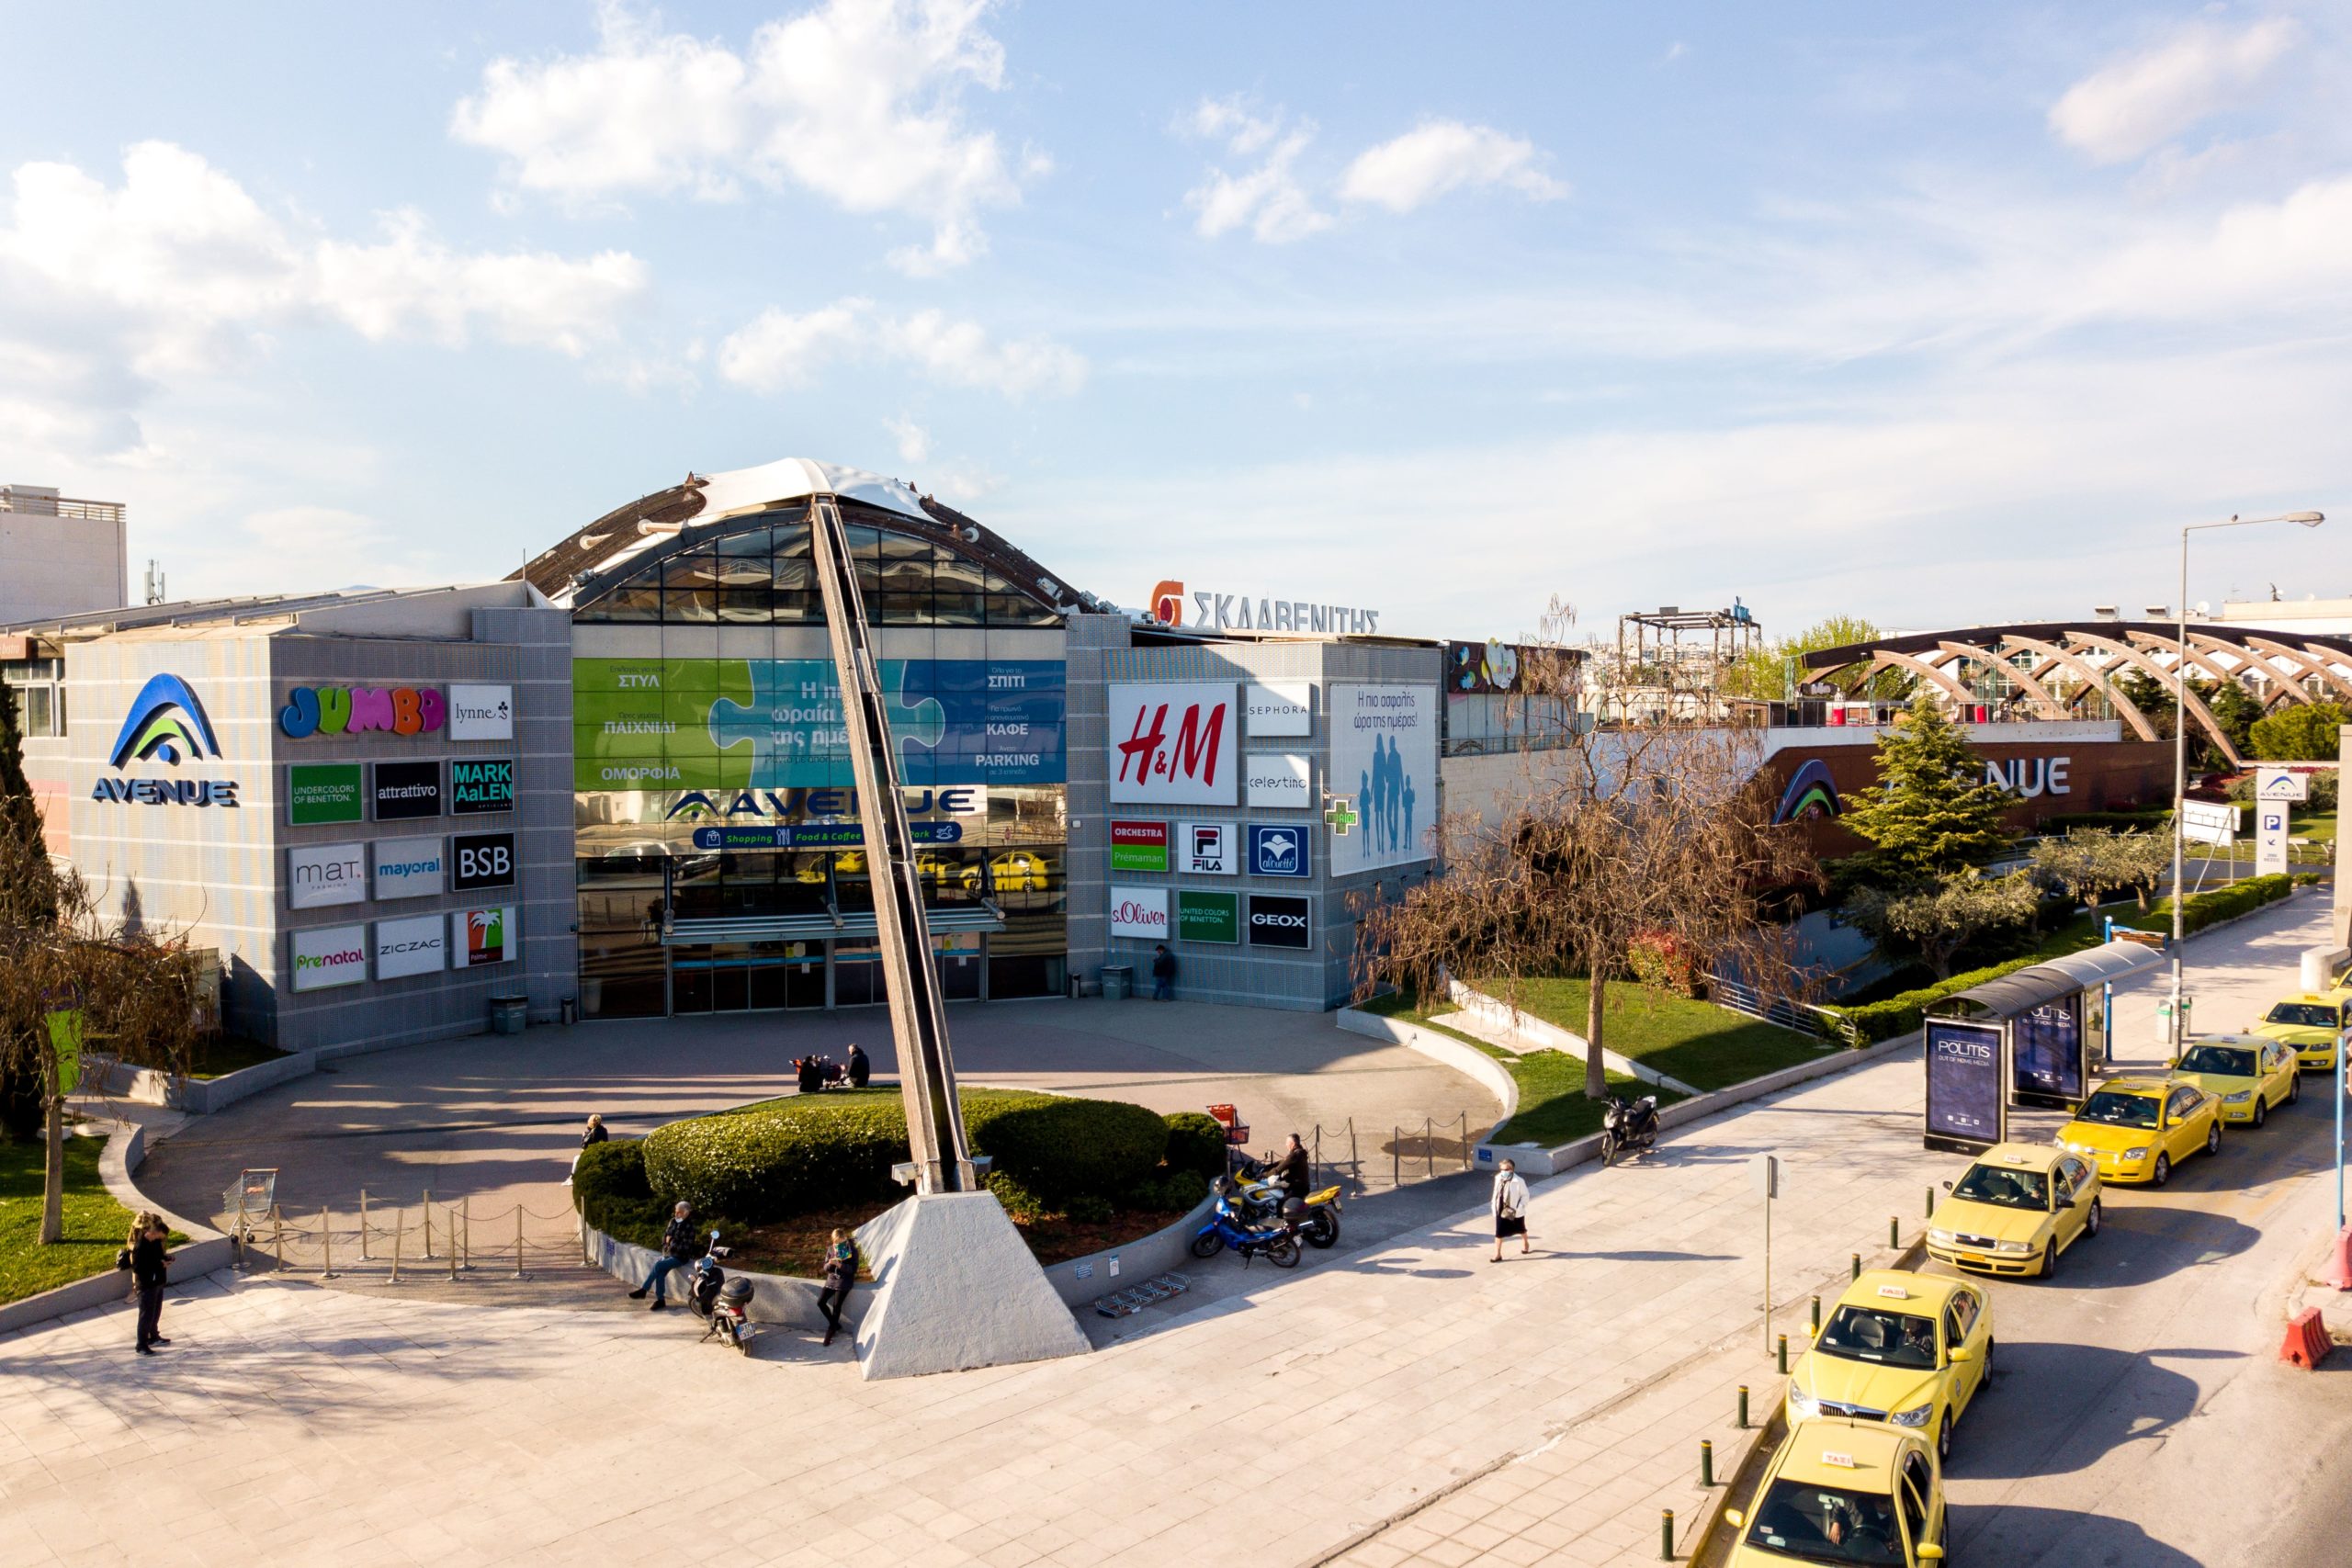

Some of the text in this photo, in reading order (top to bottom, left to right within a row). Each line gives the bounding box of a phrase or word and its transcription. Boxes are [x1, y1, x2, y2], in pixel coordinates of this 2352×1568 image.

[618, 675, 660, 687] ΣΤΥΛ
[988, 675, 1025, 687] ΣΠΙΤΙ
[801, 682, 842, 699] Η πι
[1358, 691, 1415, 711] Η πιο ασφαλής
[279, 686, 447, 738] JUMBO
[772, 705, 835, 724] ωραία
[1249, 705, 1307, 716] SEPHORA
[605, 721, 676, 735] ΠΑΙΧΝΙΔΙ
[1353, 712, 1418, 732] ώρα της ημέρας!
[987, 724, 1028, 736] ΚΑΦΕ
[771, 728, 850, 747] της ημέ
[976, 754, 1039, 766] PARKING
[454, 763, 512, 784] MARK
[602, 766, 681, 780] ΟΜΟΡΦΙΑ
[294, 784, 355, 795] UNDERCOLORS
[1250, 776, 1307, 789] celestino
[91, 778, 237, 807] AVENUE
[379, 784, 436, 799] attrattivo
[294, 795, 306, 804] OF
[727, 789, 976, 816] AVEUE
[2266, 817, 2279, 829] P
[727, 834, 773, 844] Shopping
[796, 832, 820, 841] Food
[822, 832, 828, 840] &
[831, 831, 861, 841] Coffee
[1114, 828, 1163, 838] ORCHESTRA
[460, 846, 511, 878] BSB
[1114, 852, 1163, 863] Prémaman
[379, 858, 440, 878] mayoral
[1193, 859, 1222, 871] FILA
[1112, 900, 1167, 926] s.Oliver
[1204, 908, 1229, 917] COLORS
[1251, 913, 1306, 928] GEOX
[379, 939, 441, 956] ZICZAC
[2030, 1006, 2071, 1020] OLITIS
[1939, 1041, 1990, 1058] POLITIS
